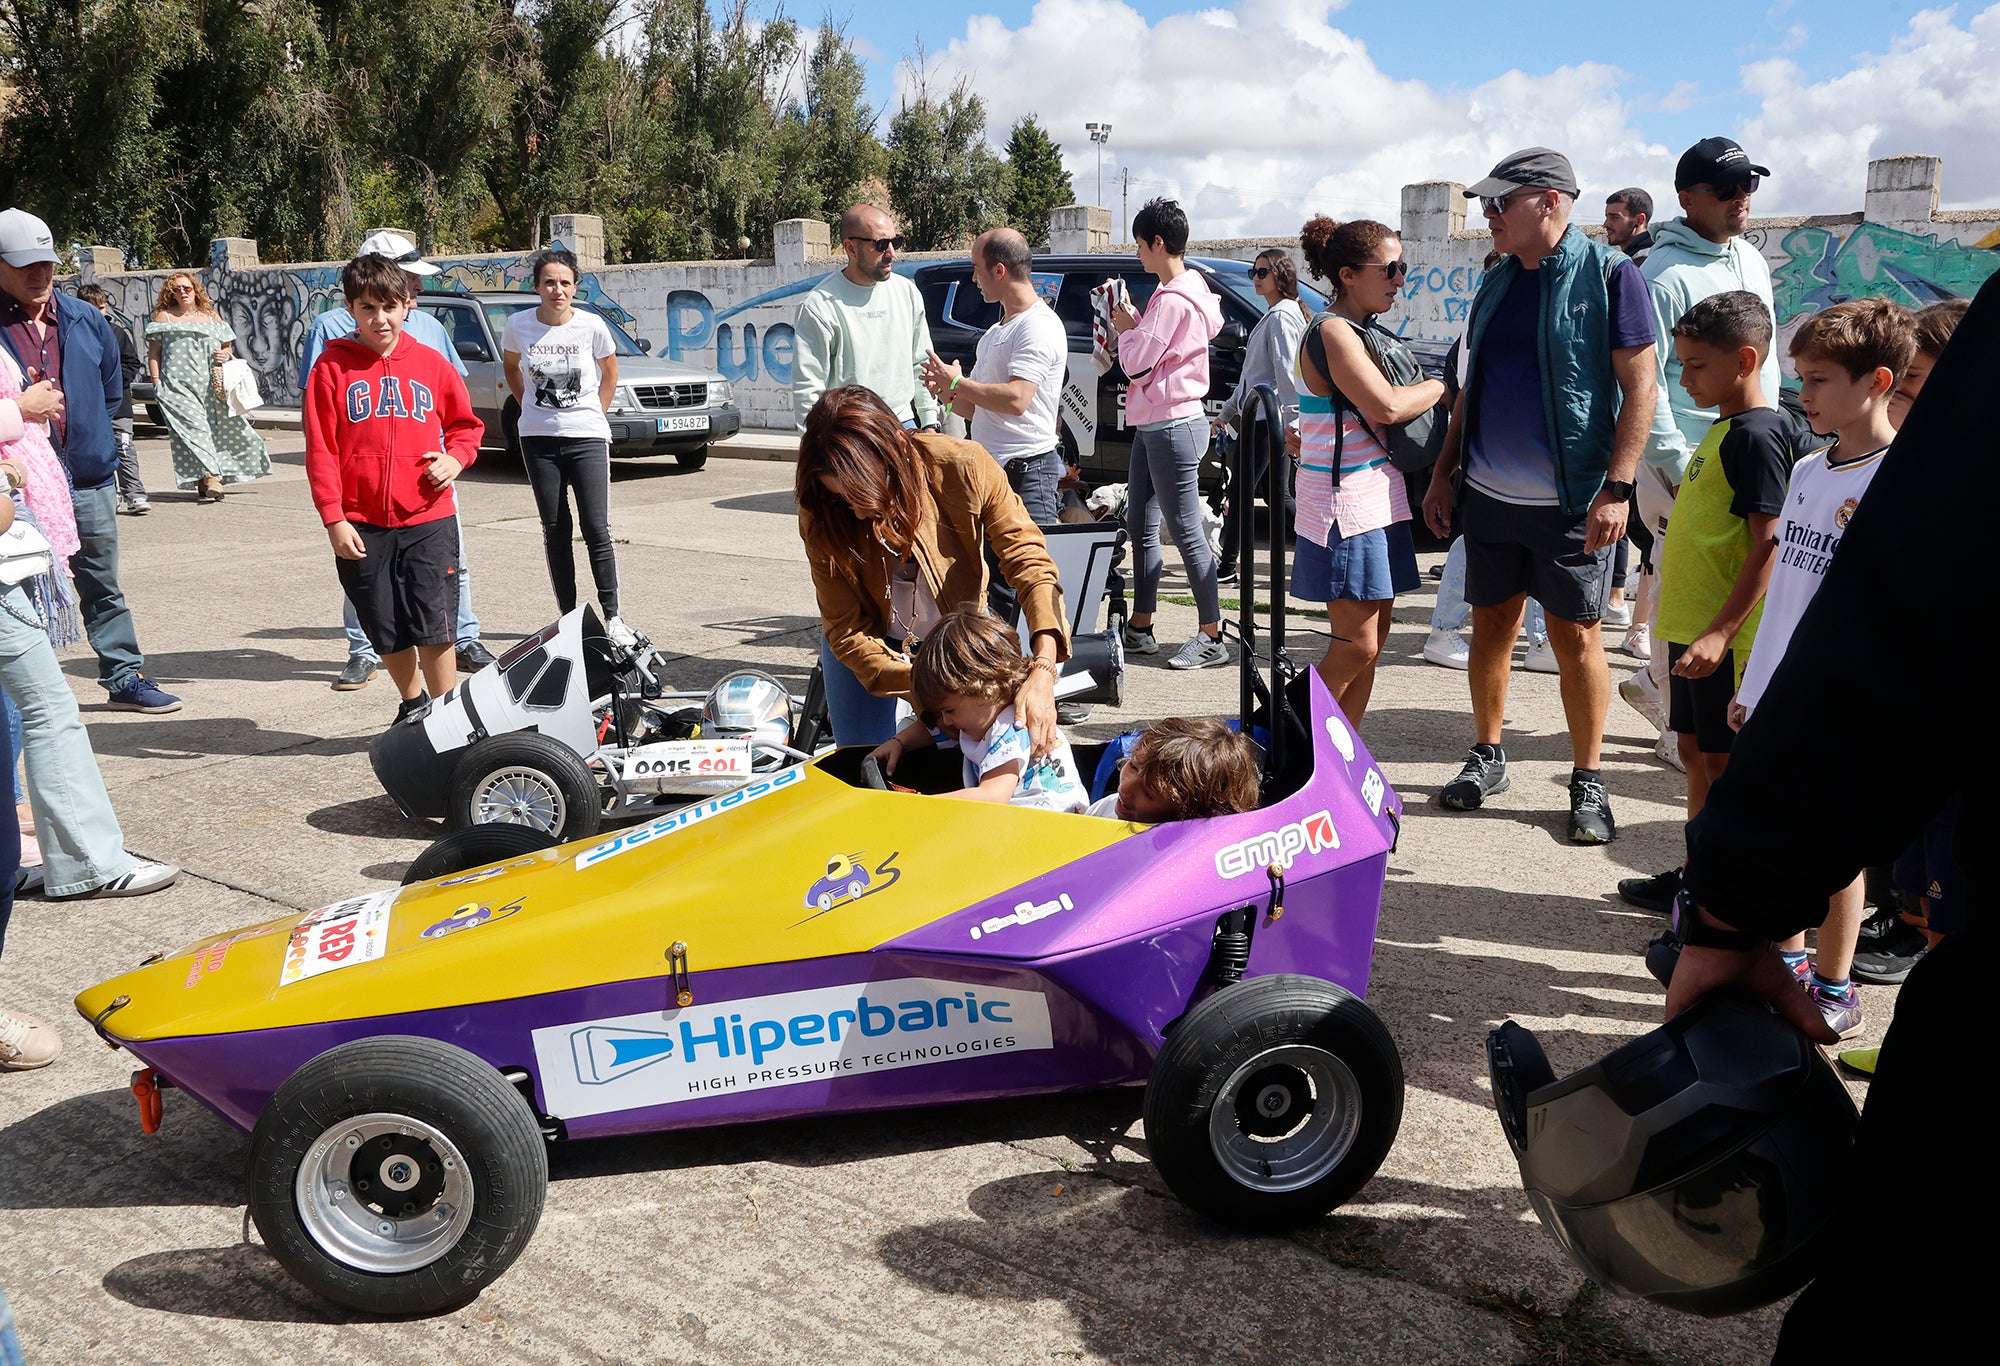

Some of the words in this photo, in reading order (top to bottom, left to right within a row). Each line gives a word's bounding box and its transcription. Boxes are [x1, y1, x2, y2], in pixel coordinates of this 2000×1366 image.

[530, 345, 580, 355] EXPLORE
[667, 290, 795, 384] Pue
[347, 376, 434, 423] GAP
[1061, 392, 1094, 433] GARANTÍA
[1069, 384, 1089, 408] AÑOS
[635, 760, 691, 774] 0015
[698, 758, 741, 773] SOL
[317, 919, 356, 962] REP
[680, 991, 1013, 1065] Hiperbaric
[688, 1075, 736, 1093] HIGH
[748, 1058, 853, 1084] PRESSURE
[862, 1036, 1017, 1067] TECHNOLOGIES
